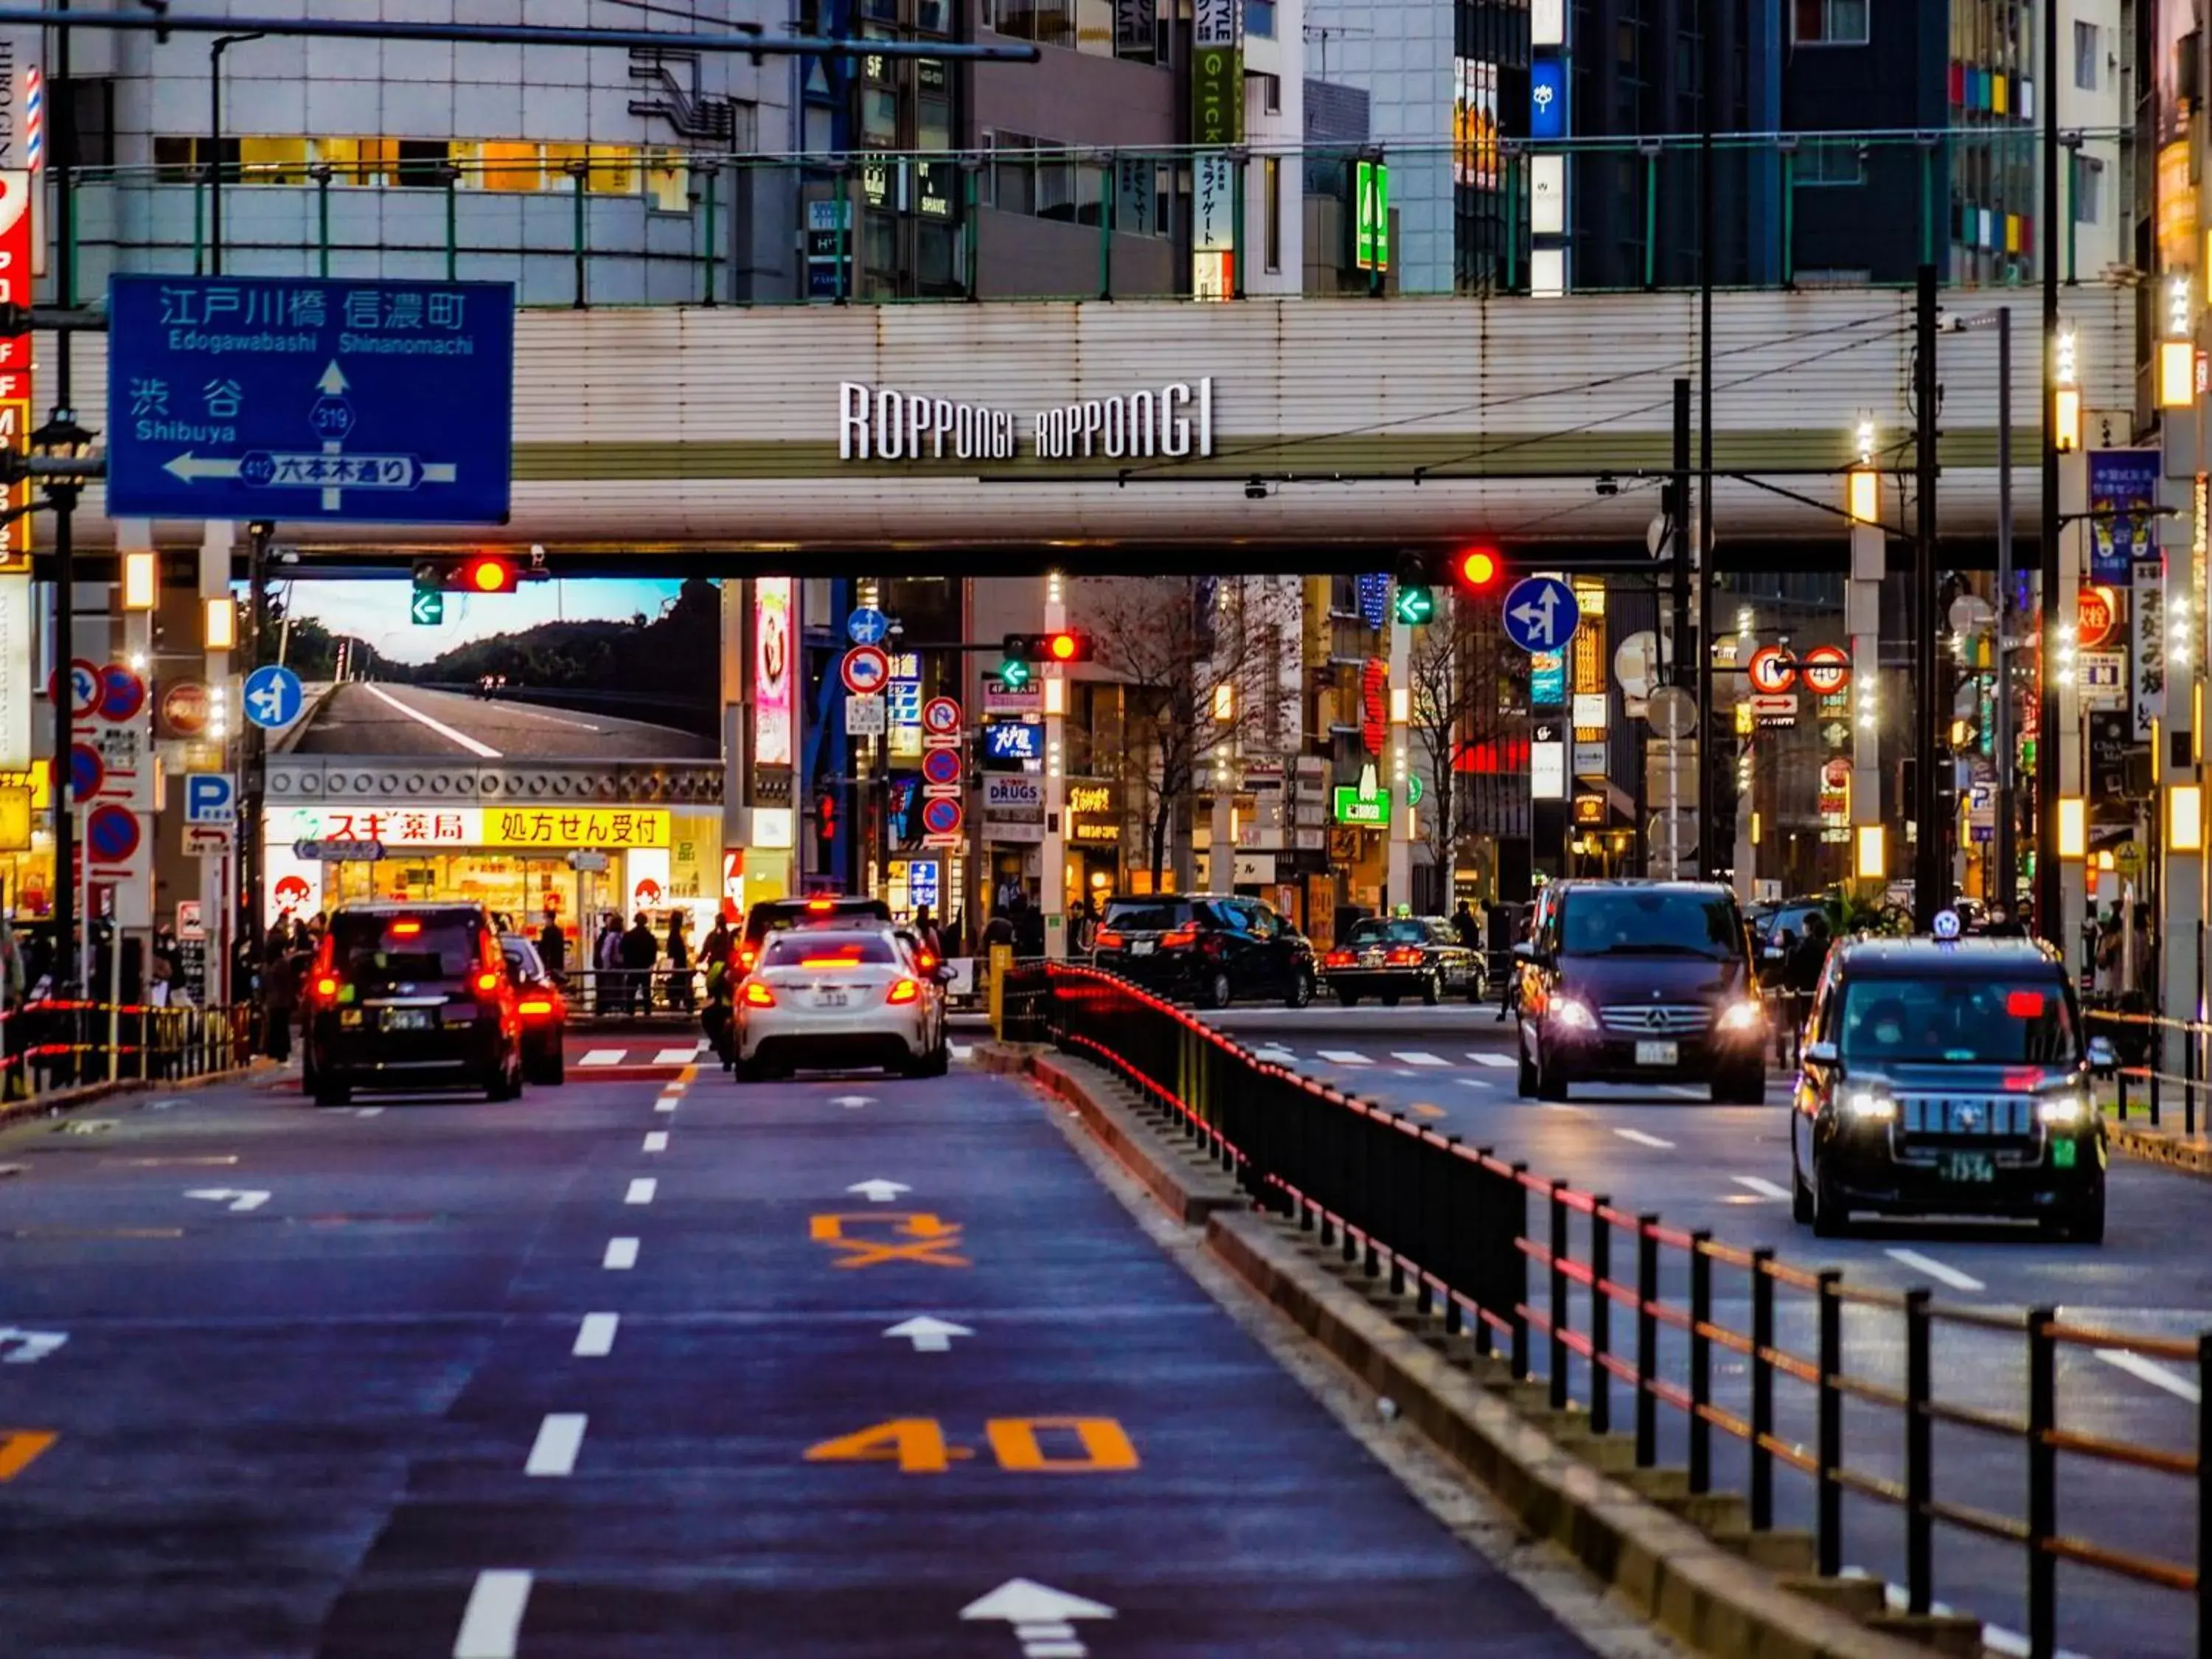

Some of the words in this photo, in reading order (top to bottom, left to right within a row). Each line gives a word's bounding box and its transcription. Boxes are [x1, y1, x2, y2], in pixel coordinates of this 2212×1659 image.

[160, 286, 327, 327] 江戸川橋
[342, 290, 467, 330] 信濃町
[169, 329, 317, 354] Edogawabashi
[338, 334, 473, 355] Shinanomachi
[130, 376, 244, 417] 渋谷
[136, 420, 236, 444] Shibuya
[317, 408, 347, 428] 319
[840, 381, 1013, 459] ROPPONGI
[1037, 377, 1212, 458] ROPPONGI
[277, 459, 405, 483] 六本木通り
[190, 776, 230, 818] P
[990, 786, 1037, 799] DRUGS
[325, 810, 463, 841] スギ薬局
[501, 812, 656, 843] 処方せん受付
[804, 1417, 1140, 1472] 40
